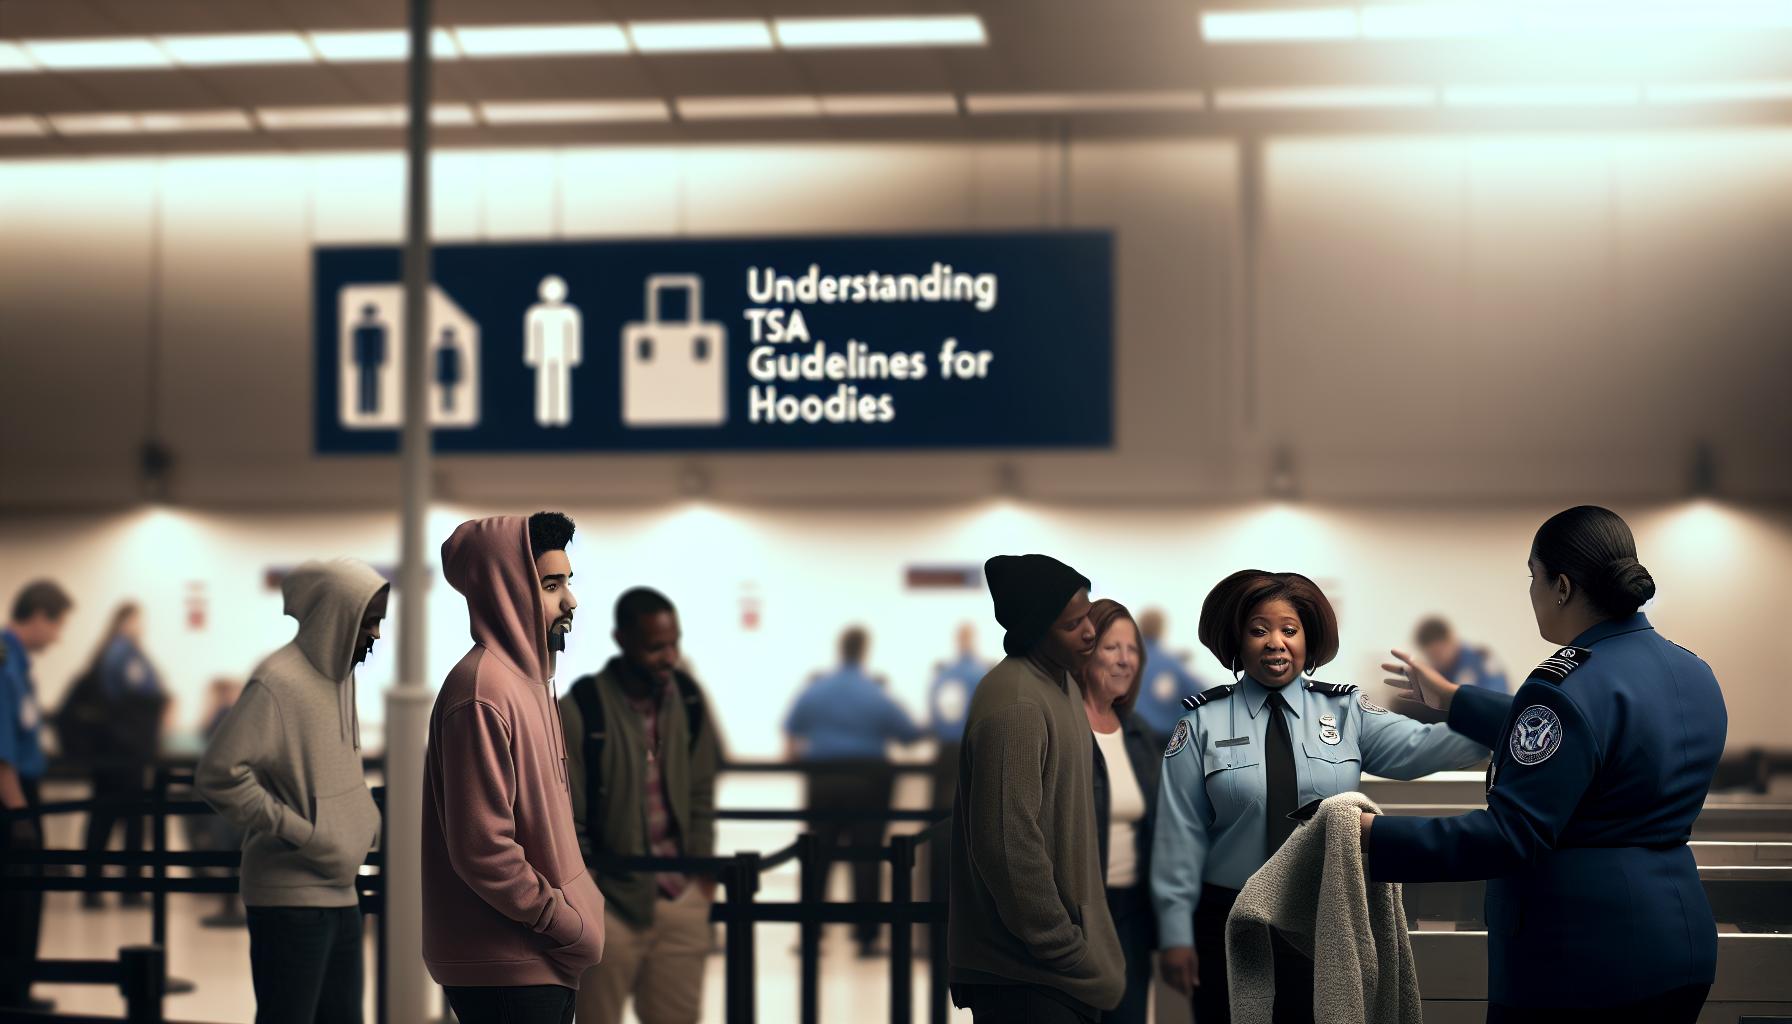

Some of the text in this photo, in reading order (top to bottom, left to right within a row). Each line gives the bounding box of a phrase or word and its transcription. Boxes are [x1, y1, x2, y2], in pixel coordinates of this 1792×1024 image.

[747, 262, 997, 311] Understanding
[743, 307, 810, 343] TSA
[748, 338, 993, 381] Gudelines for
[749, 383, 895, 423] Hoodies
